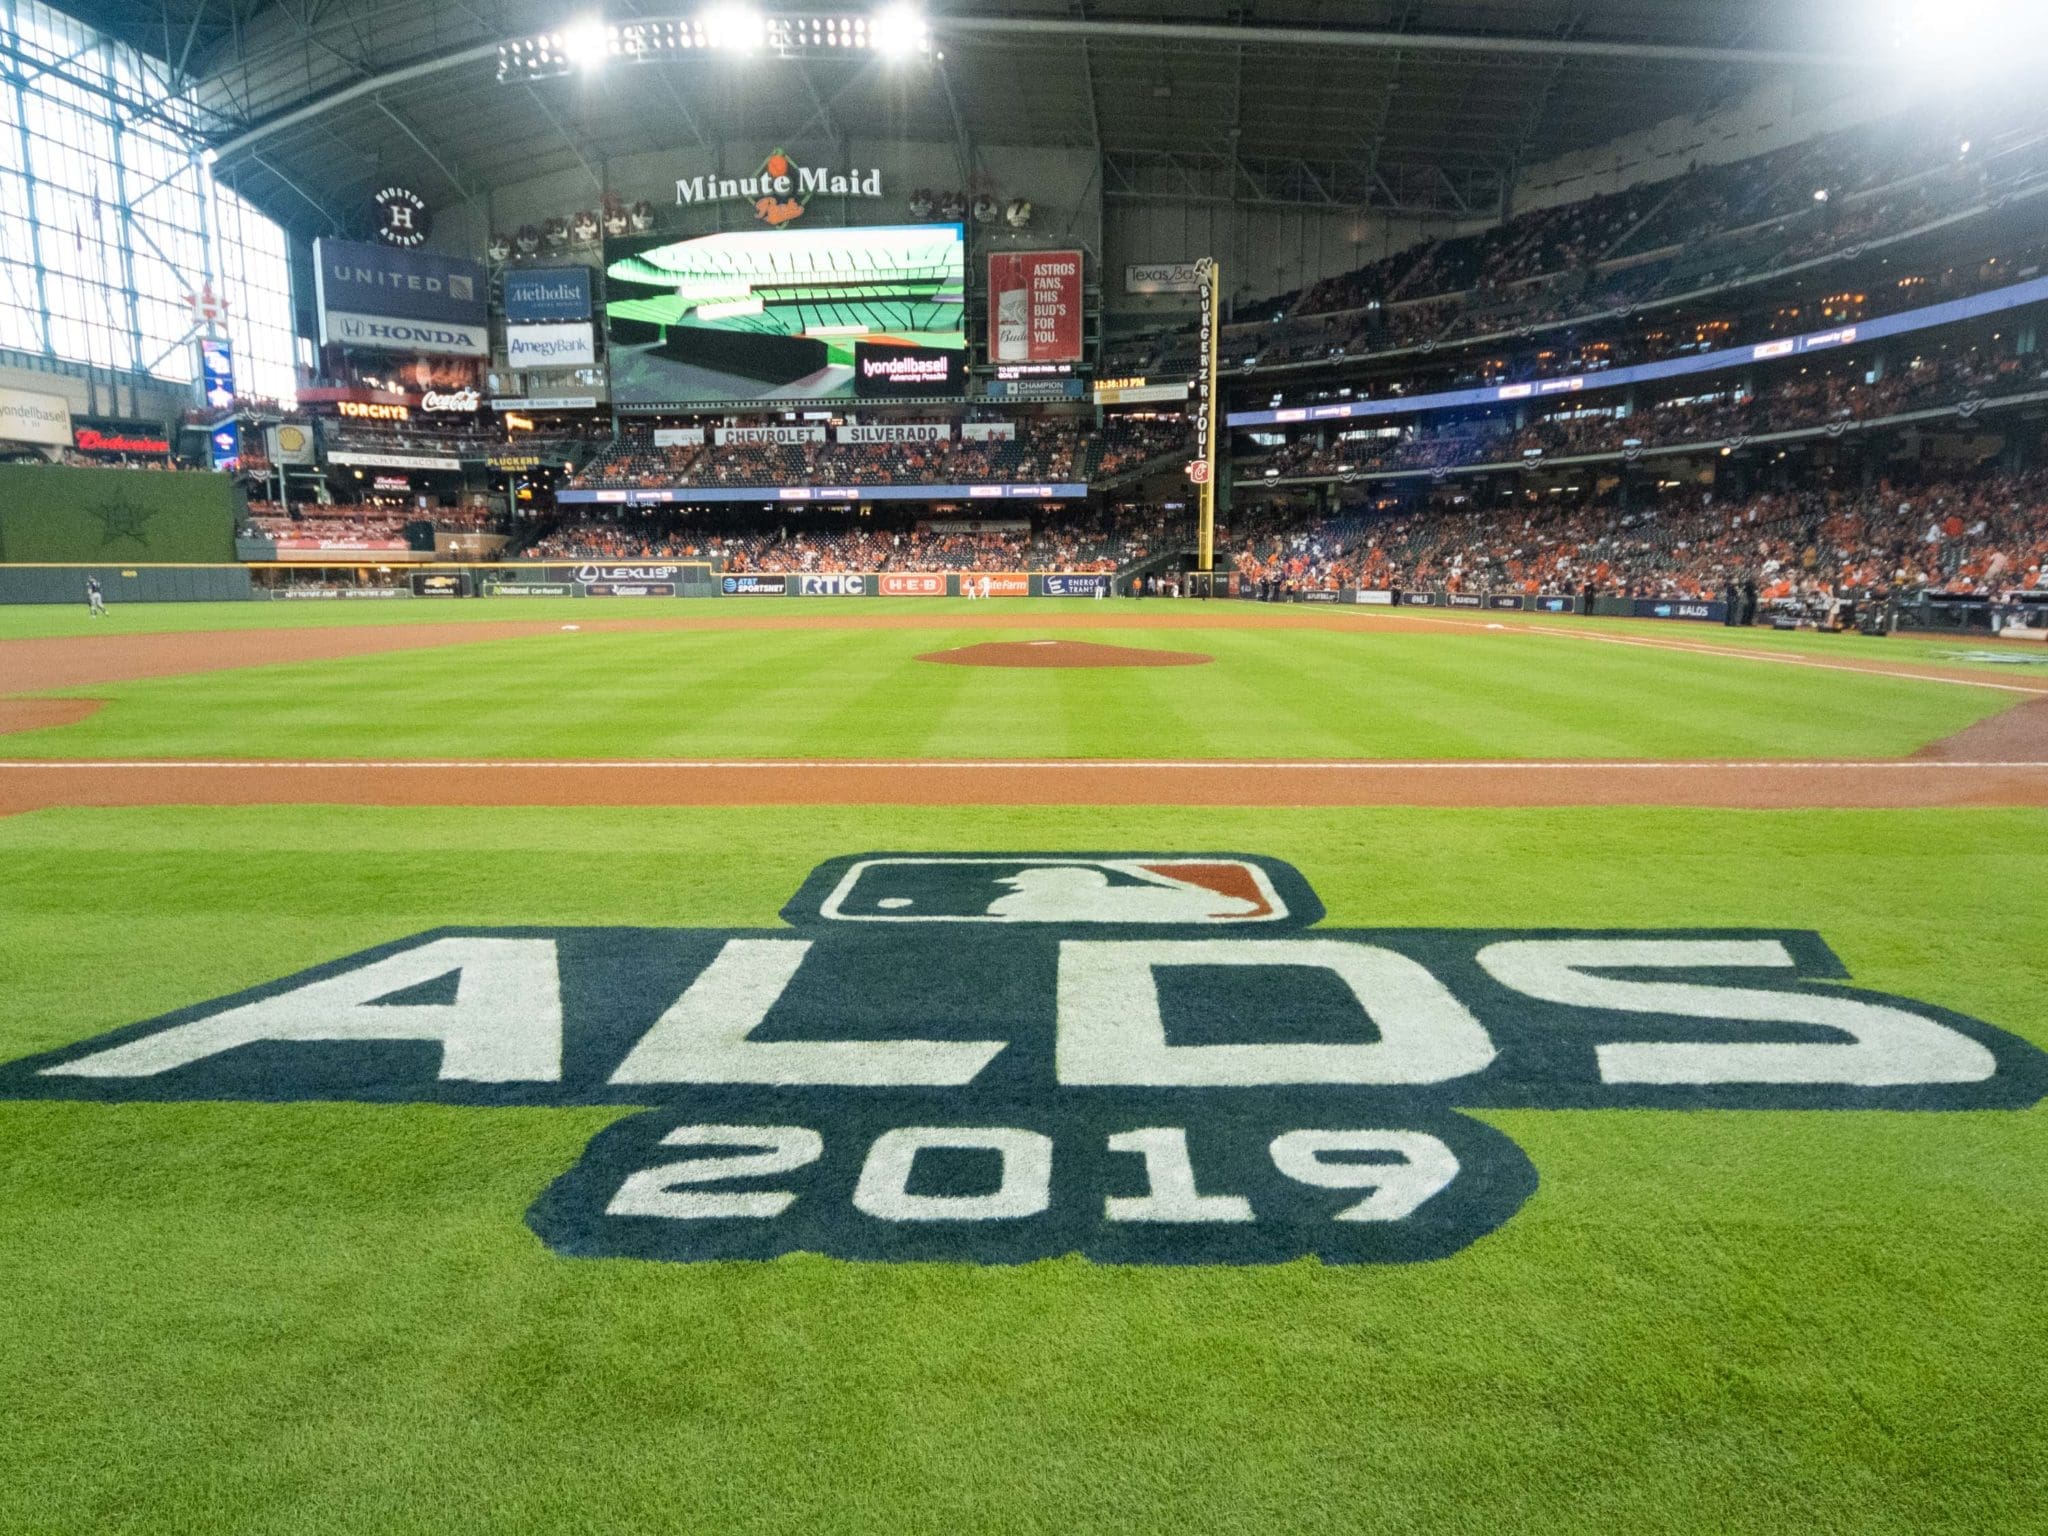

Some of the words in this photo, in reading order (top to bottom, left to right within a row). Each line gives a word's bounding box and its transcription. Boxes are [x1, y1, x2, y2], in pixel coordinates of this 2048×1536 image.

[675, 172, 791, 206] Minute
[797, 166, 883, 197] Maid
[375, 187, 425, 210] HOUSTON
[390, 204, 414, 230] H
[380, 227, 424, 246] ASTROS
[1033, 263, 1076, 277] ASTROS
[1130, 266, 1168, 280] Texas
[334, 265, 442, 292] UNITED
[1033, 277, 1064, 292] FANS,
[512, 284, 582, 302] Methodist
[1033, 290, 1058, 303] THIS
[1033, 303, 1067, 317] BUD'S
[1033, 317, 1055, 330] FOR
[368, 323, 476, 346] HONDA
[1033, 331, 1059, 344] YOU.
[864, 356, 948, 377] lyondellbasell
[1018, 382, 1064, 390] CHAMPION
[725, 427, 816, 443] CHEVROLET
[850, 426, 938, 442] SILVERADO
[1197, 403, 1209, 458] FOUL
[487, 456, 540, 466] PLUCKERS
[601, 567, 668, 579] LEXUS
[501, 586, 530, 595] National
[737, 584, 785, 593] SPORTSNET
[802, 575, 863, 594] RTIC
[35, 935, 1998, 1088] ALDS
[604, 1123, 1462, 1223] 2019
